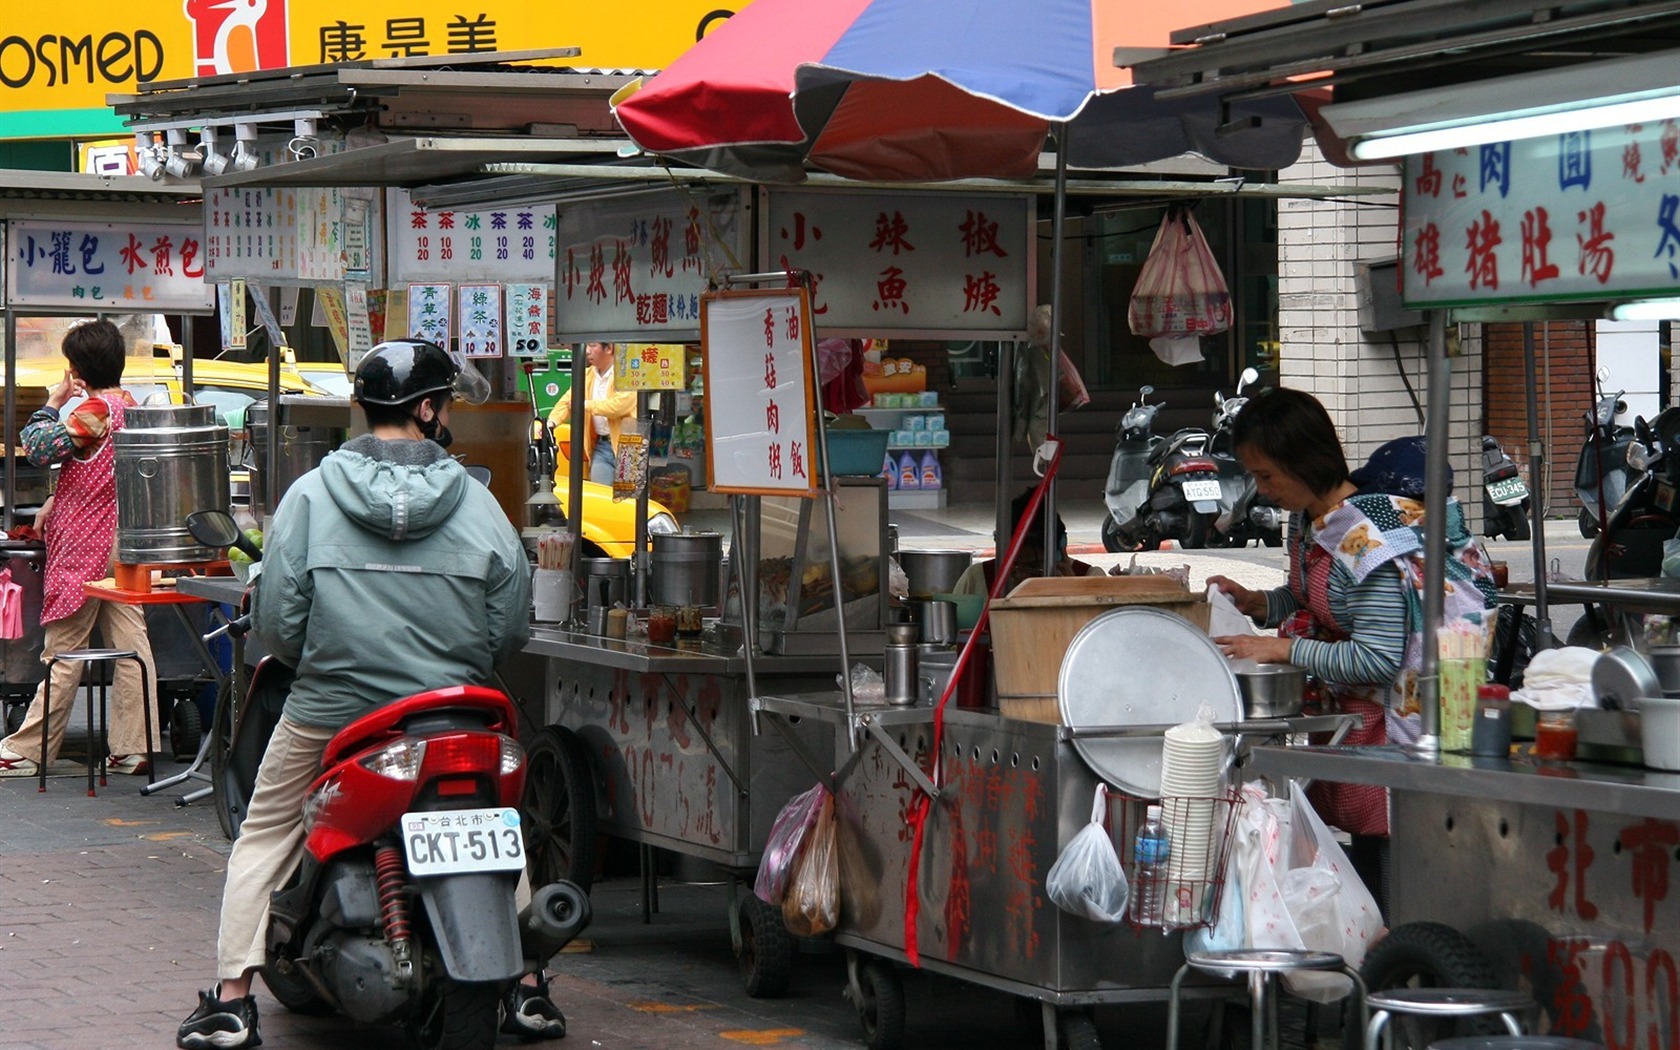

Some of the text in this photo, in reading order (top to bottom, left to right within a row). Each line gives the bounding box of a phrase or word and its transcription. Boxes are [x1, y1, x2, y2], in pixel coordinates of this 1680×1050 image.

[490, 212, 507, 230] 茶
[517, 212, 533, 230] 茶
[781, 208, 1008, 258] 小辣椒
[418, 237, 429, 248] 10
[440, 237, 451, 248] 10
[471, 237, 481, 248] 10
[497, 237, 508, 248] 10
[523, 237, 534, 248] 20
[20, 231, 205, 278] 小籠包 水煎包
[418, 249, 429, 260] 20
[441, 249, 452, 260] 20
[470, 249, 482, 260] 20
[497, 249, 508, 260] 20
[523, 249, 534, 260] 40
[562, 239, 636, 307] 小辣椒
[72, 285, 104, 300] 肉包
[422, 287, 438, 331] 青草茶
[465, 343, 476, 354] 10
[485, 341, 496, 353] 20
[516, 338, 540, 353] 50
[764, 308, 782, 480] 香菇肉粥
[441, 813, 483, 827] 台北市
